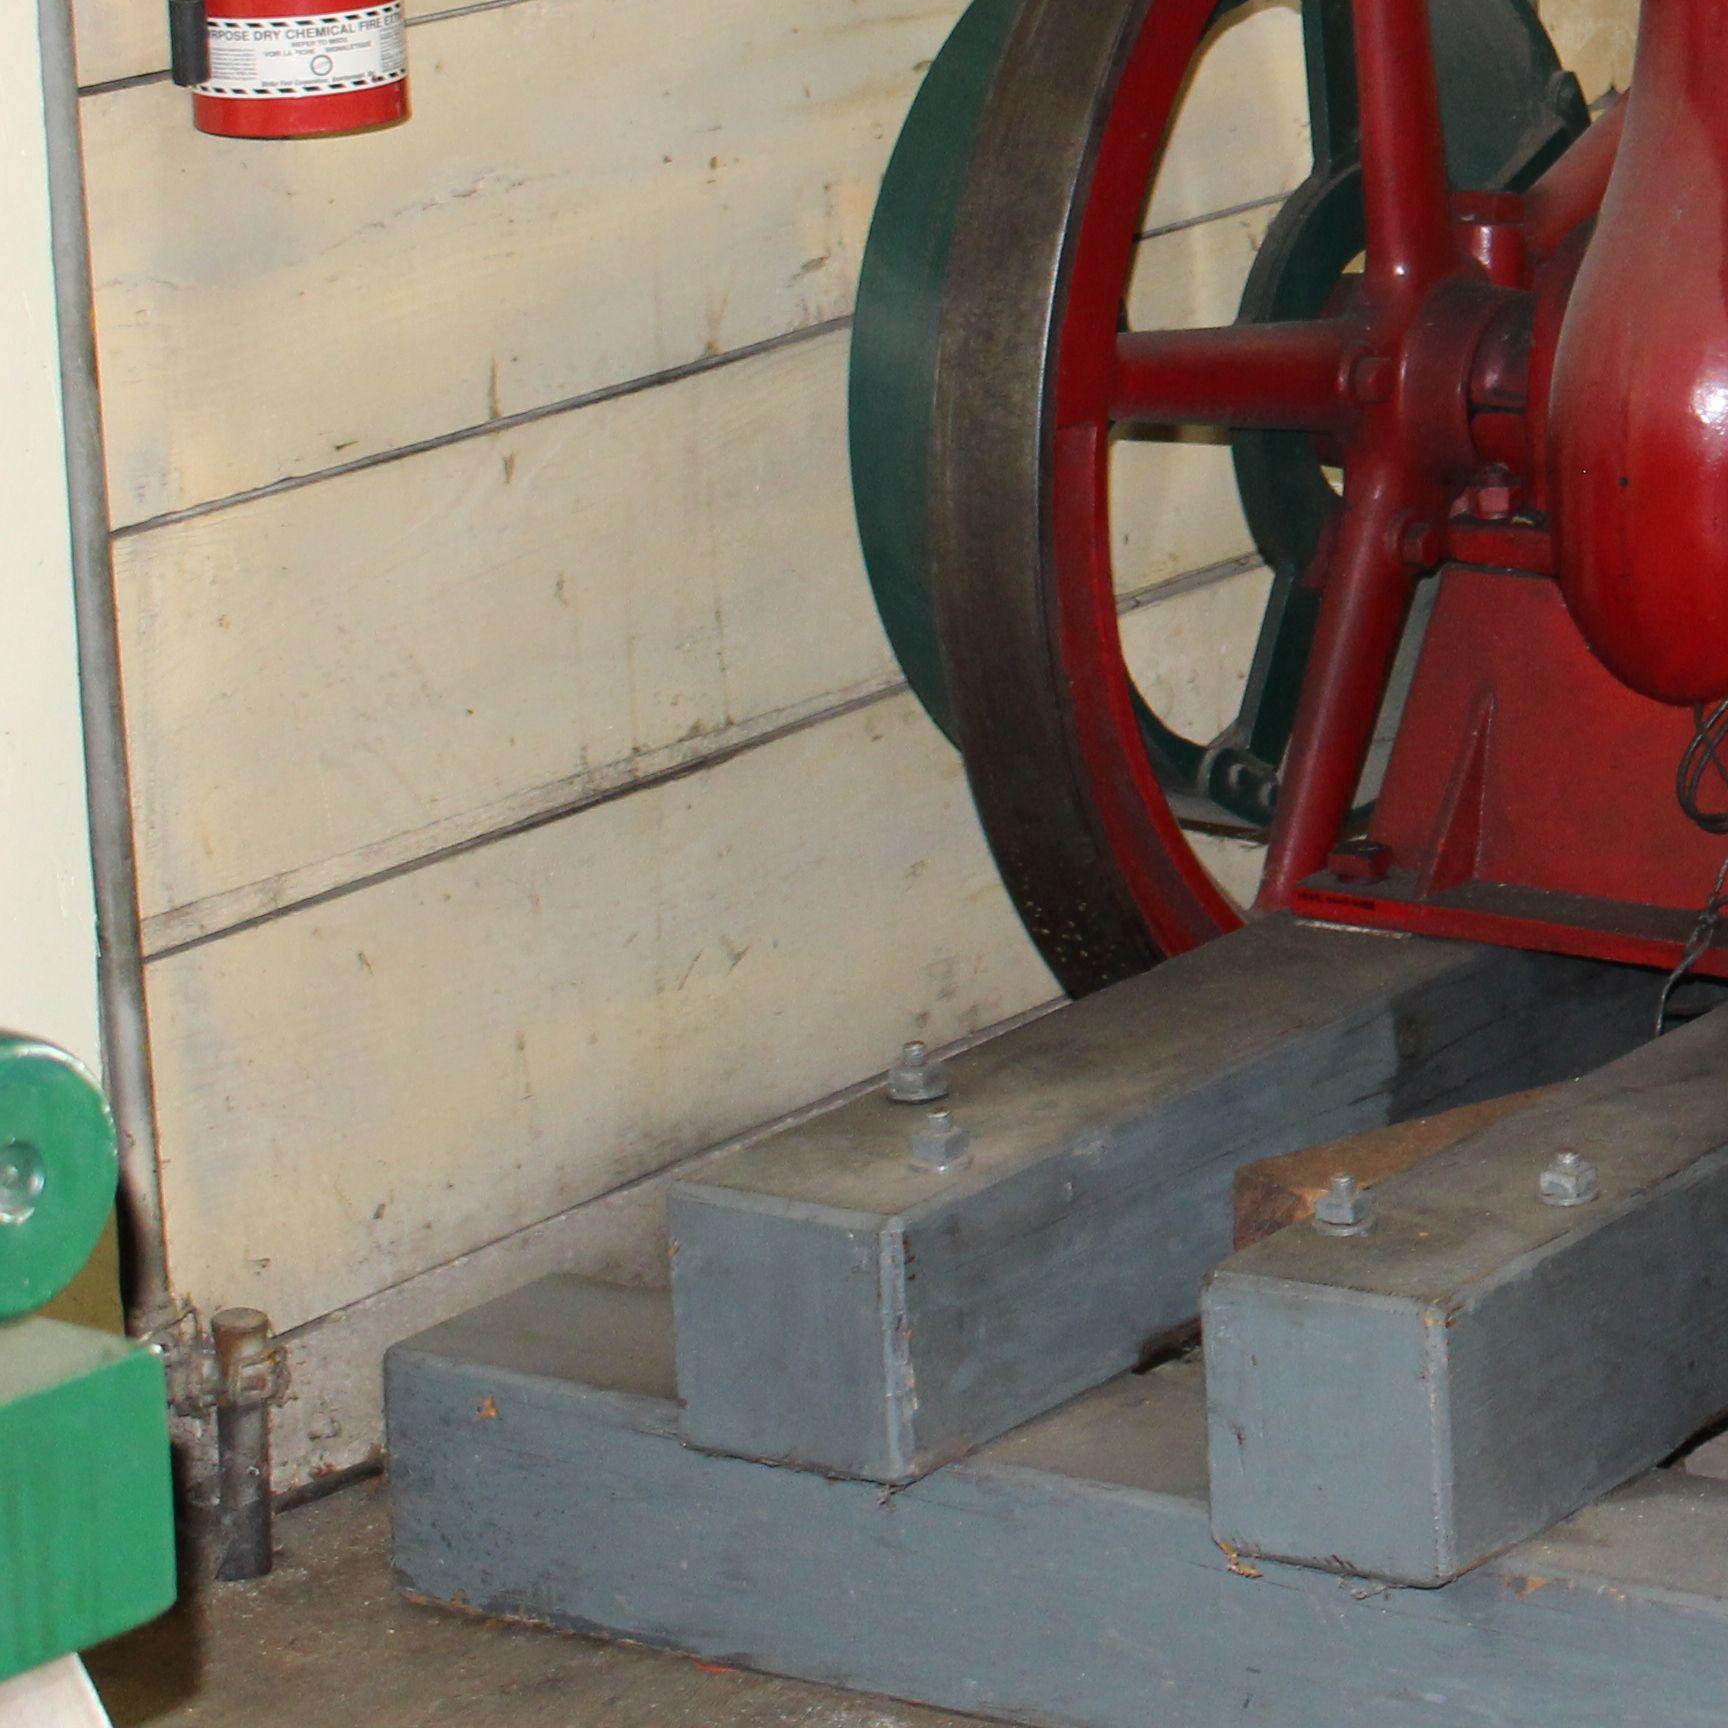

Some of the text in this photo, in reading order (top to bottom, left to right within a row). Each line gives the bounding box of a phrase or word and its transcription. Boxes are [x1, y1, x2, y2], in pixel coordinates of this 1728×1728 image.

[208, 30, 250, 42] RPOSE
[253, 29, 281, 42] DRY
[285, 25, 355, 40] CHEMICAL
[359, 19, 381, 33] FIRE
